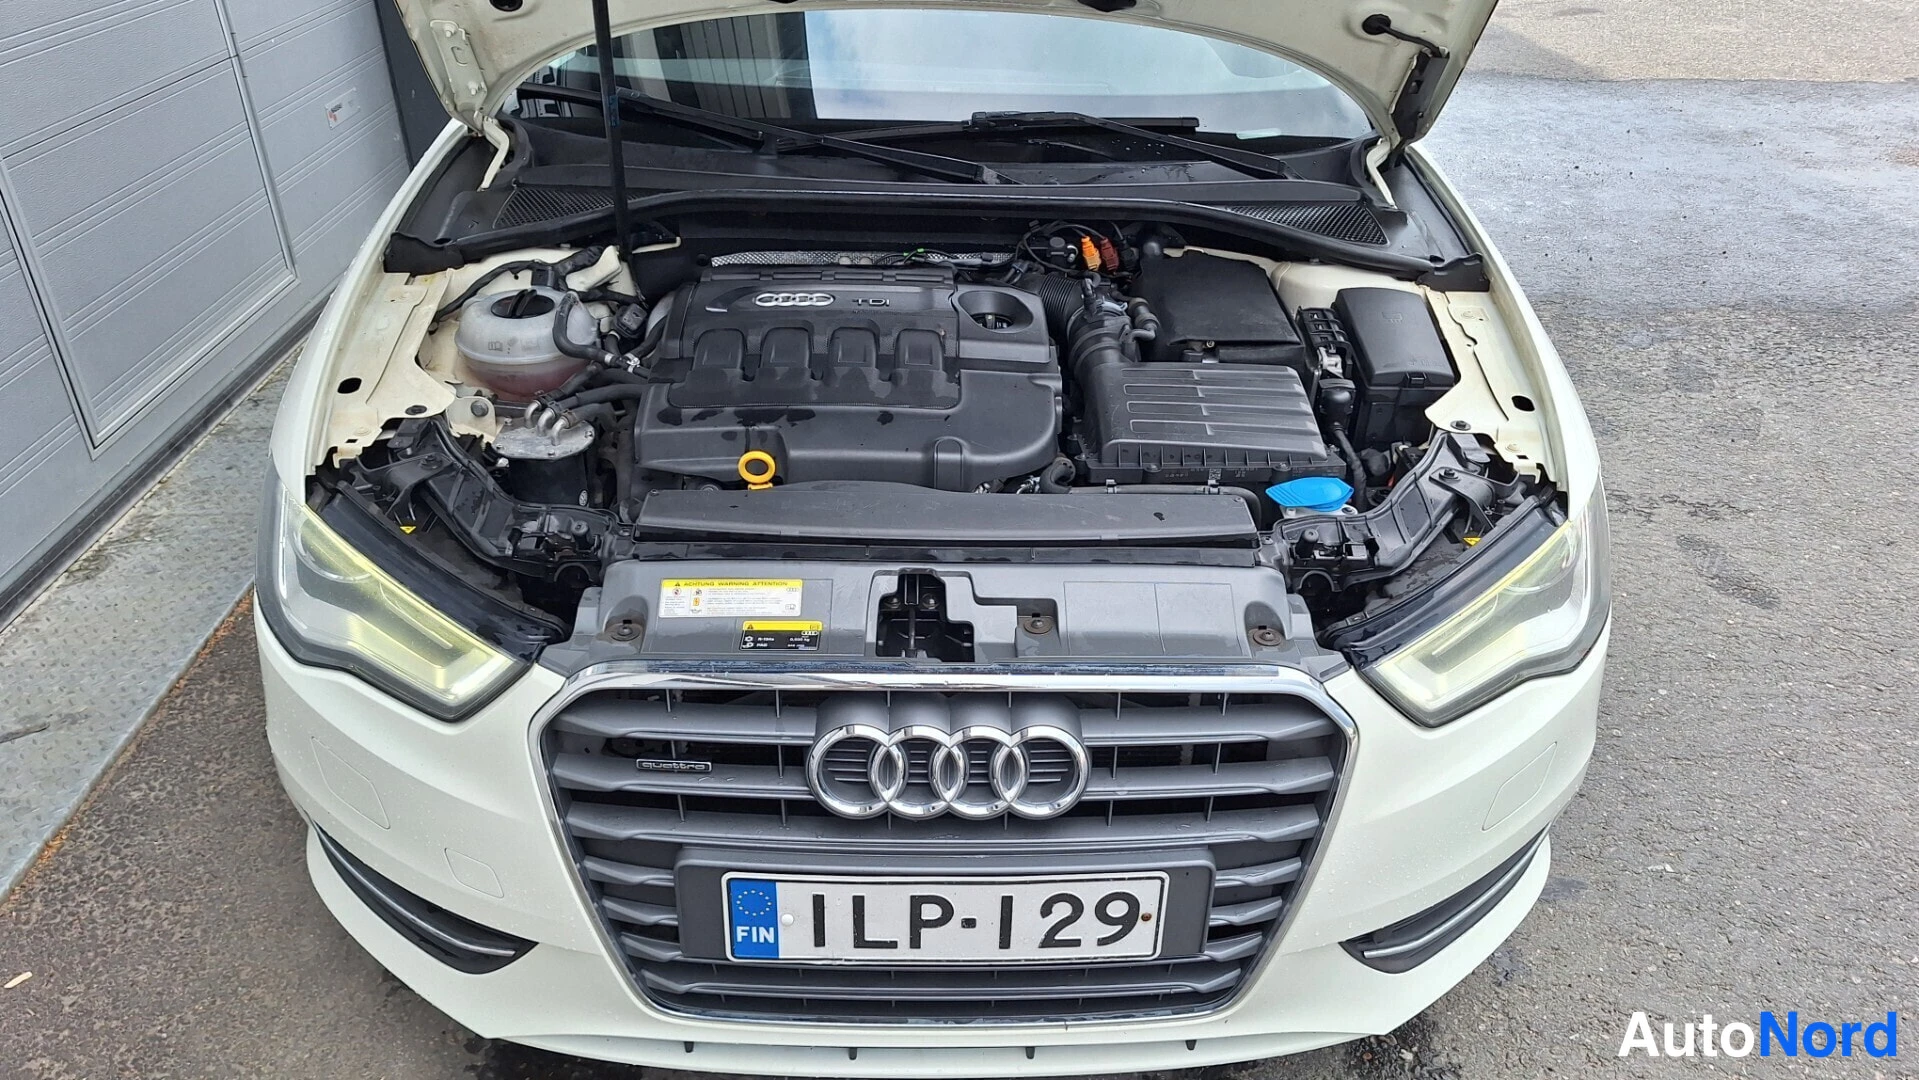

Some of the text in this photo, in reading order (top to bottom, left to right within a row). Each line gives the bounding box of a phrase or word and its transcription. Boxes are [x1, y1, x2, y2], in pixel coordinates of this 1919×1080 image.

[852, 298, 891, 308] TDI
[642, 762, 706, 770] quattro
[812, 891, 1142, 951] ILP-129
[736, 926, 775, 944] FIN
